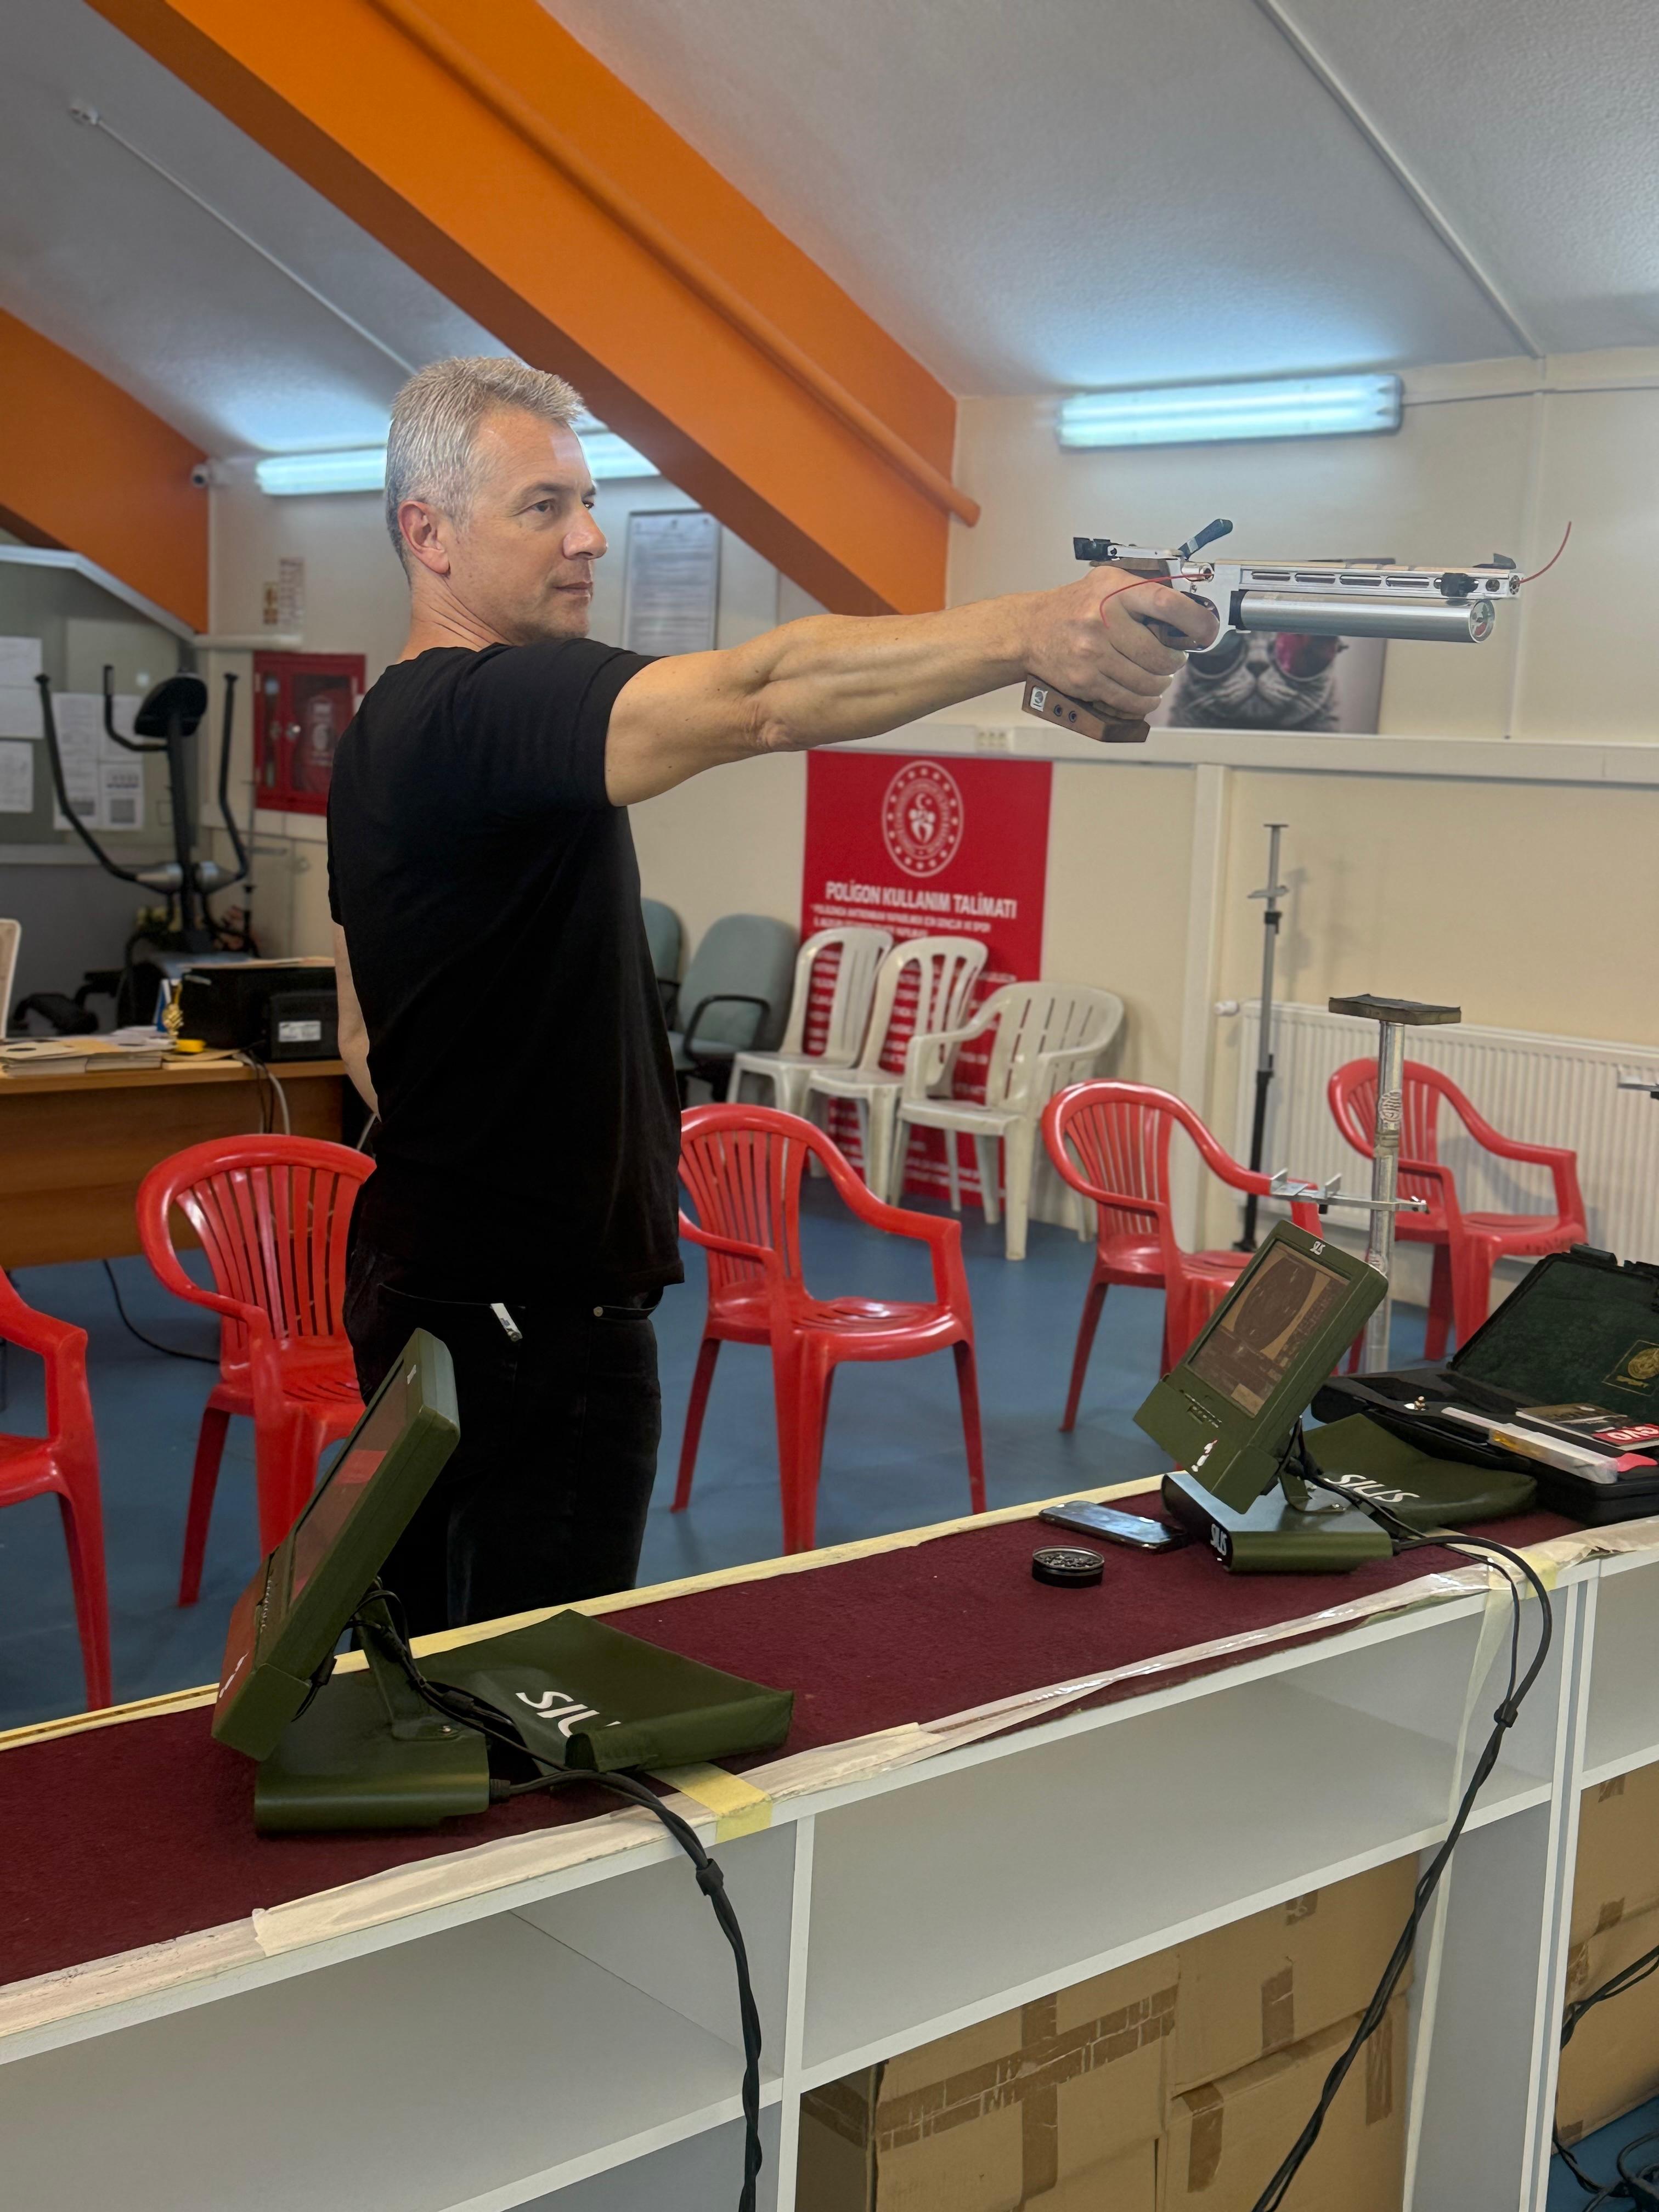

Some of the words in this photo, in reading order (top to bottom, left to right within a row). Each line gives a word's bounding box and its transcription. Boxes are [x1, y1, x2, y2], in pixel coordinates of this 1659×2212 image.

[825, 879, 881, 905] POLİGON
[883, 886, 950, 911] KULLANIM
[953, 892, 1017, 919] TALİMATI
[1323, 1474, 1420, 1503] SIUS
